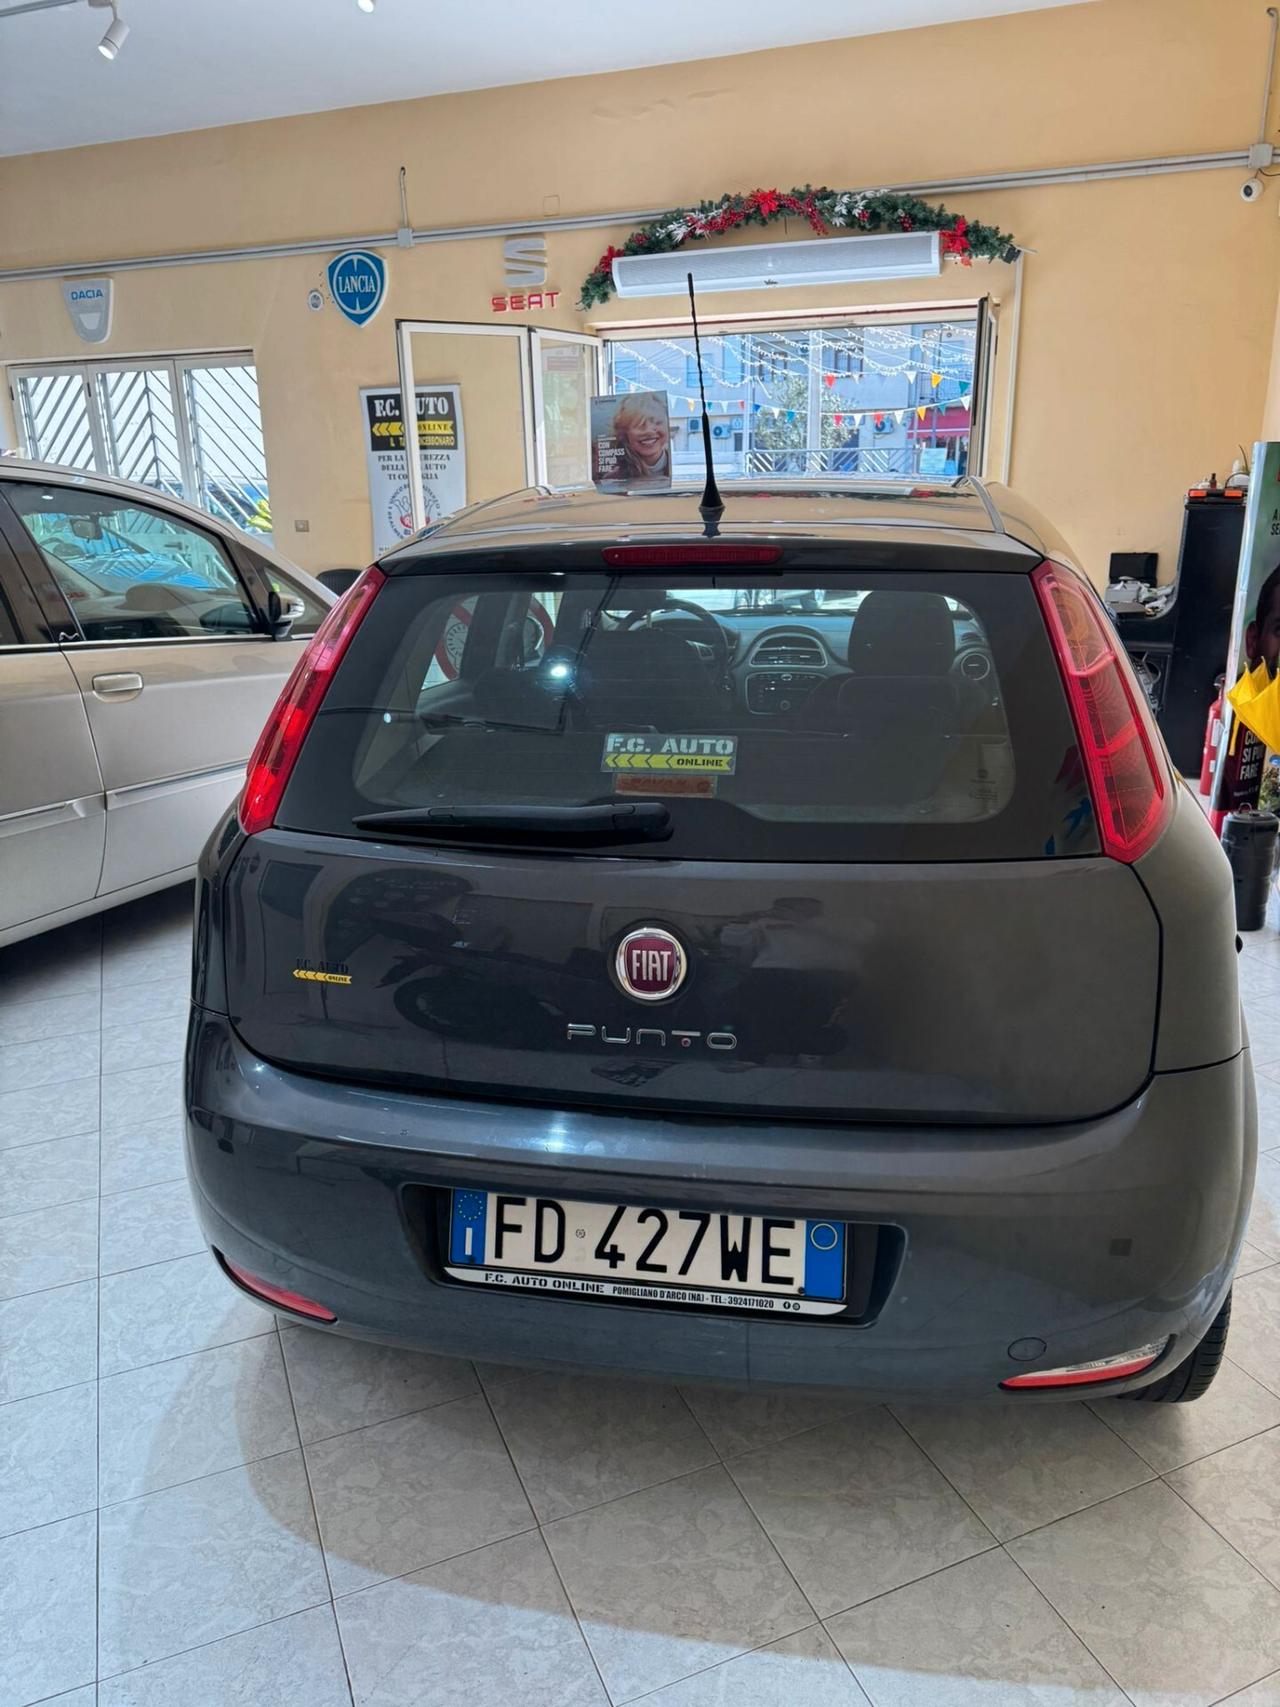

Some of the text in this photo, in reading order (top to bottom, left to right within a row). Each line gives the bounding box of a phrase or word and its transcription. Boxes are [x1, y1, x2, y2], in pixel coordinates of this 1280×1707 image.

[338, 275, 377, 294] LANCIA
[71, 288, 104, 301] DACIA
[491, 291, 560, 313] SEAT
[378, 454, 393, 462] PER
[394, 454, 404, 462] LA
[381, 464, 405, 472] DELLA
[424, 463, 447, 471] AUTO
[606, 737, 734, 755] F.C. AUTO
[676, 758, 724, 767] ONLINE
[1240, 761, 1259, 780] FARE
[632, 950, 672, 981] FIAT
[567, 1023, 738, 1050] PUNTO
[494, 1195, 796, 1286] FD 427WE
[485, 1272, 507, 1283] F.C.
[512, 1275, 548, 1288] AUTO
[552, 1279, 605, 1294] ONLINE
[612, 1285, 658, 1299] POMIGLIANO
[659, 1289, 687, 1301] D'ARCO
[728, 1295, 774, 1309] 3924171020
